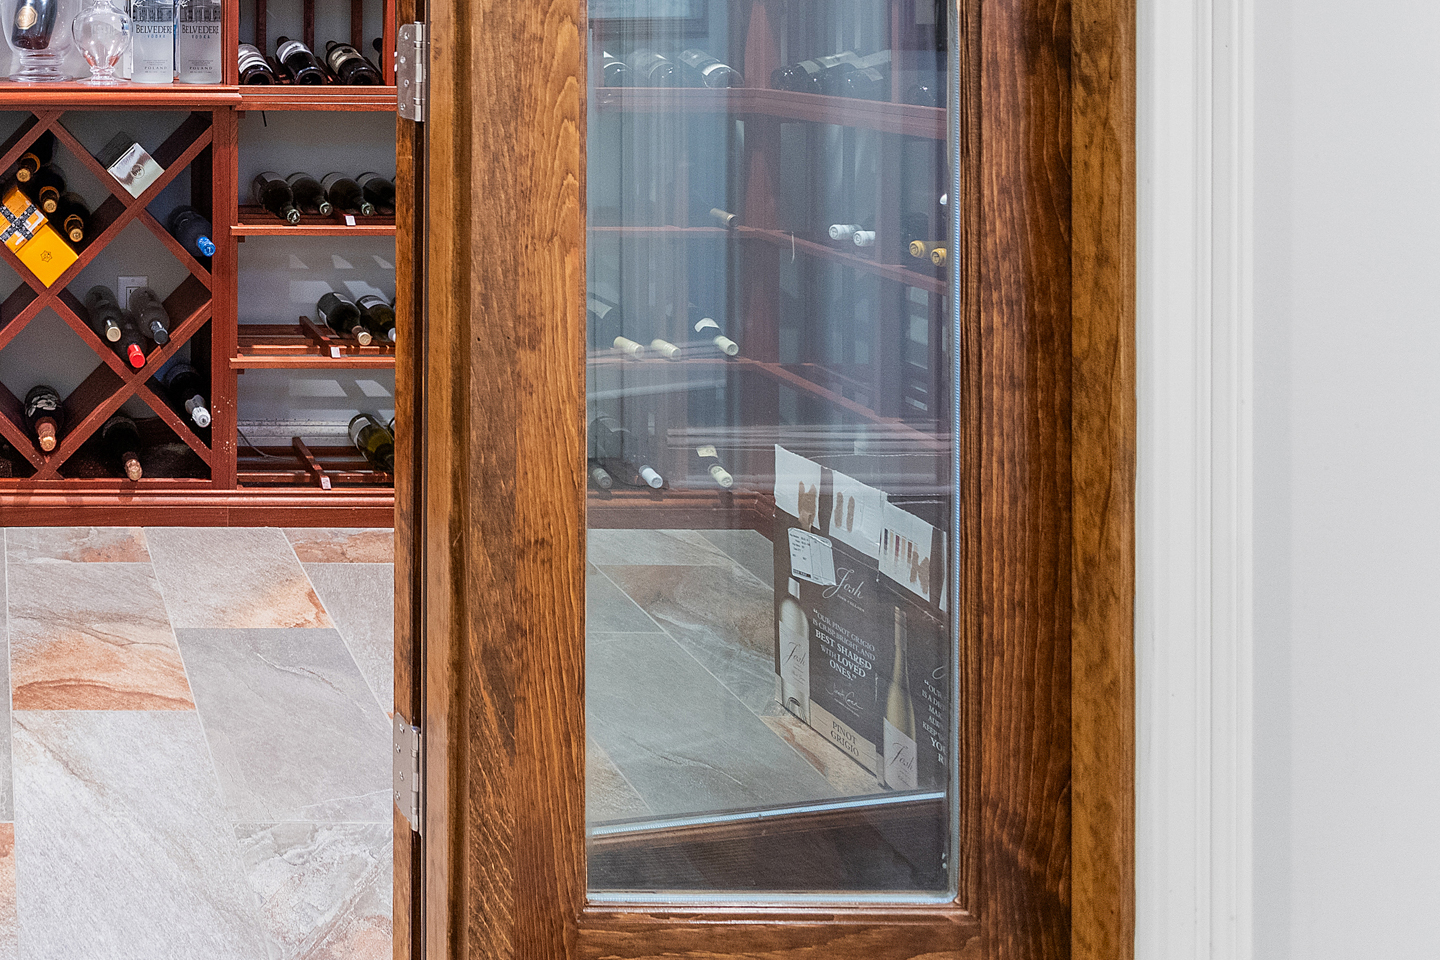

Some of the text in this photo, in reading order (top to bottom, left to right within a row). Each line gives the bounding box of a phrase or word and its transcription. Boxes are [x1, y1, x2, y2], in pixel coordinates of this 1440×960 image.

[135, 24, 172, 34] BELVEDERE
[181, 24, 220, 34] BELVEDERE
[822, 568, 864, 599] Josh
[815, 629, 872, 670] BEST SHARED
[832, 621, 850, 637] PINOT
[850, 633, 875, 652] GRIGIO
[820, 644, 866, 678] WITH LOVED
[860, 648, 876, 661] AND
[830, 730, 860, 757] GRIGIO
[832, 720, 857, 745] PINOT
